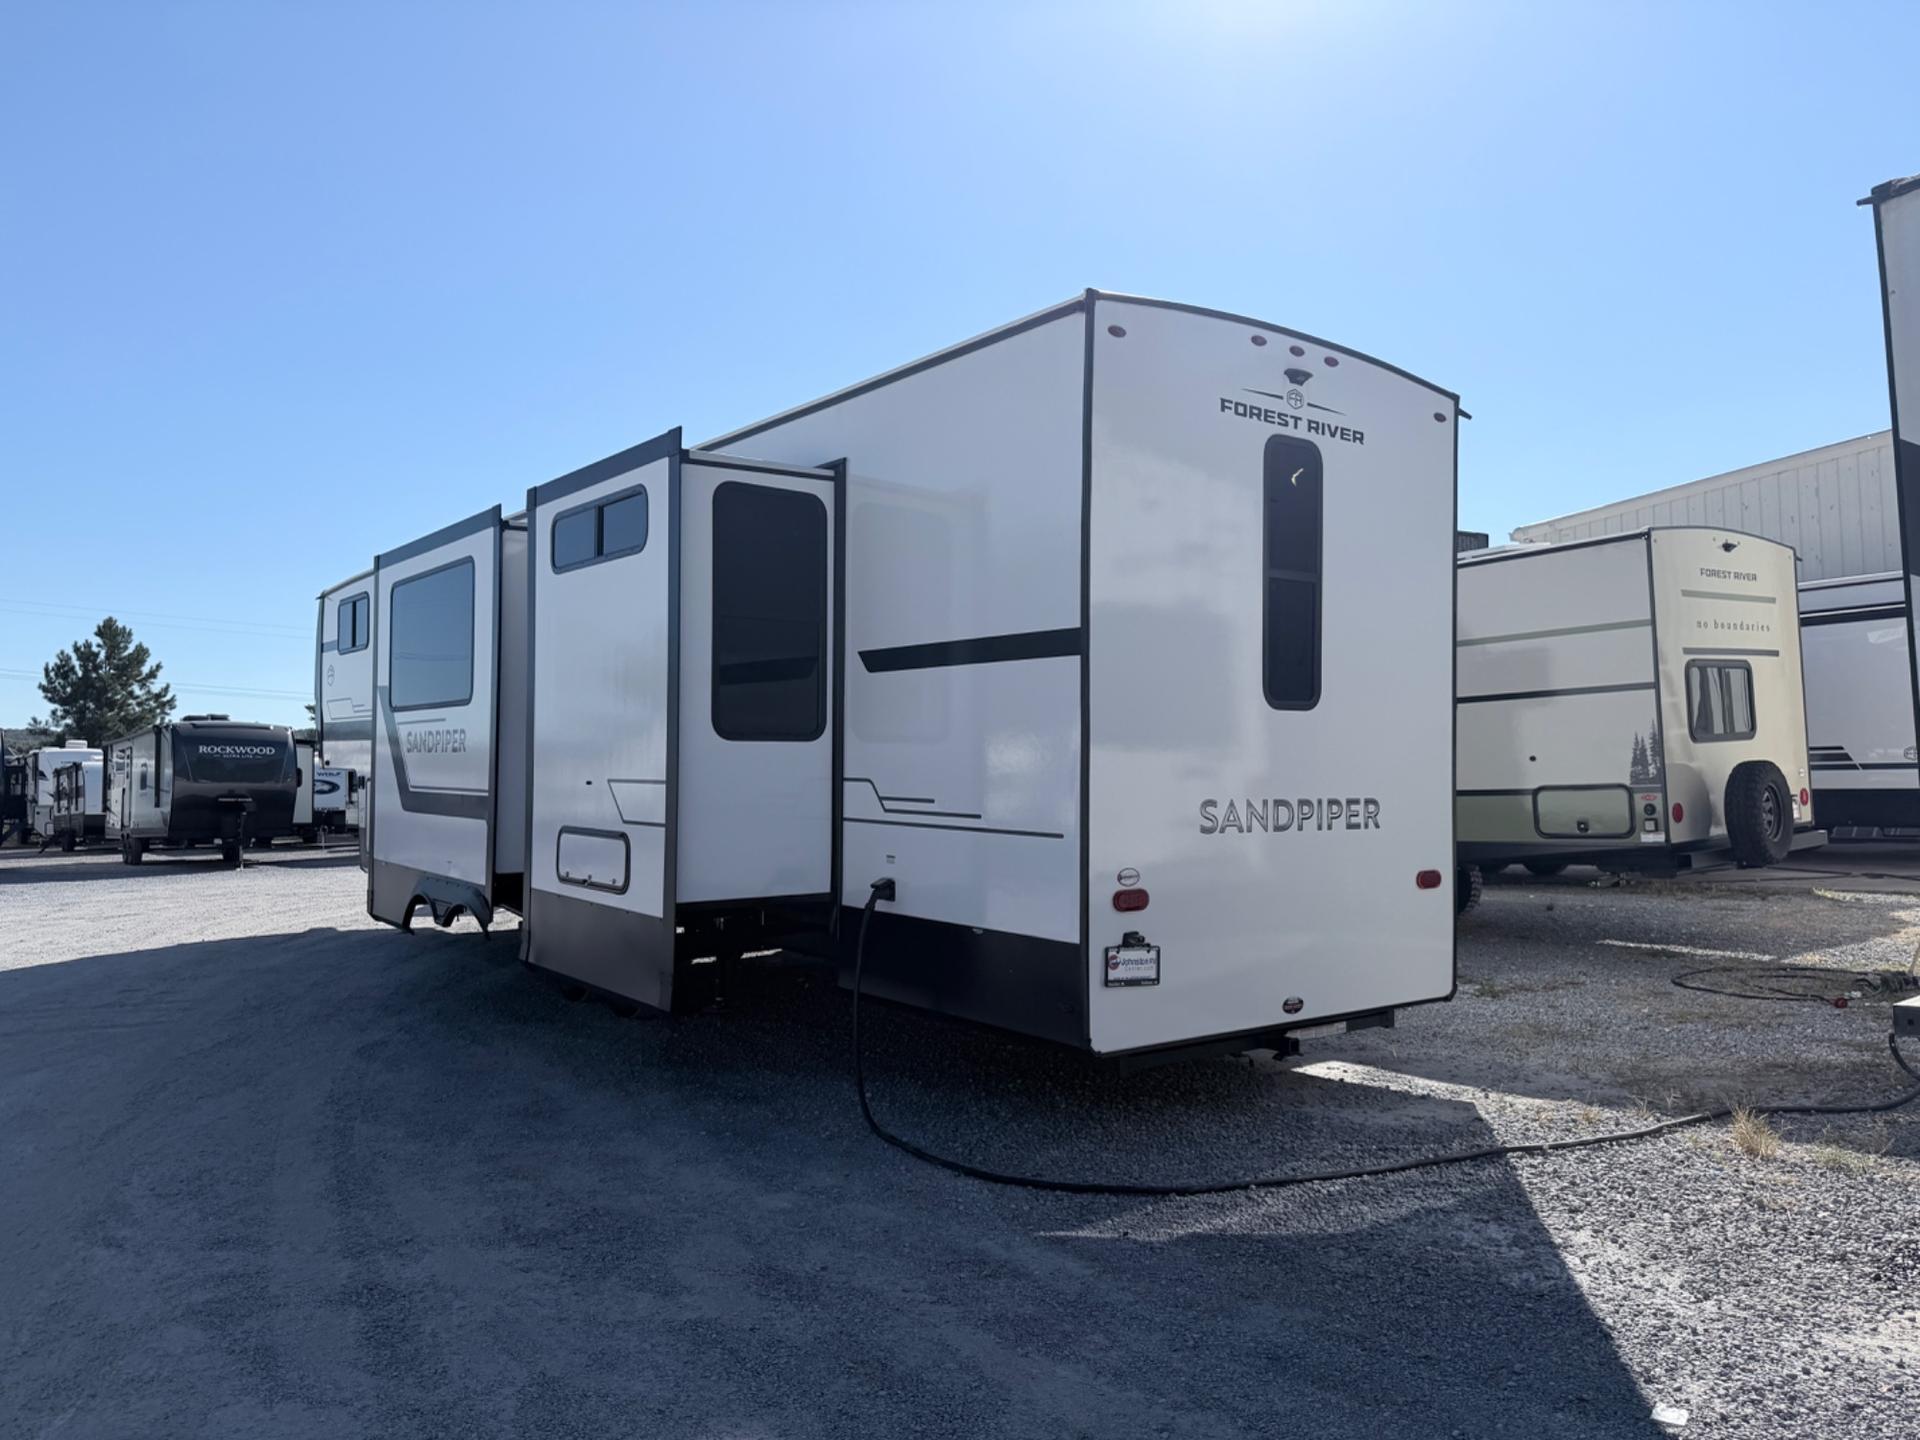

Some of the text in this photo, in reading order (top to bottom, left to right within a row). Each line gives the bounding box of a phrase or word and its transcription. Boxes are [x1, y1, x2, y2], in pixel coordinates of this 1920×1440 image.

[1220, 398, 1364, 445] FOREST RIVER
[1699, 567, 1757, 582] FOREST RIVER
[1696, 619, 1770, 632] no boundaries
[198, 744, 275, 755] ROCKWOOD
[406, 728, 466, 754] SANDPIPER
[1199, 798, 1381, 835] SANDPIPER
